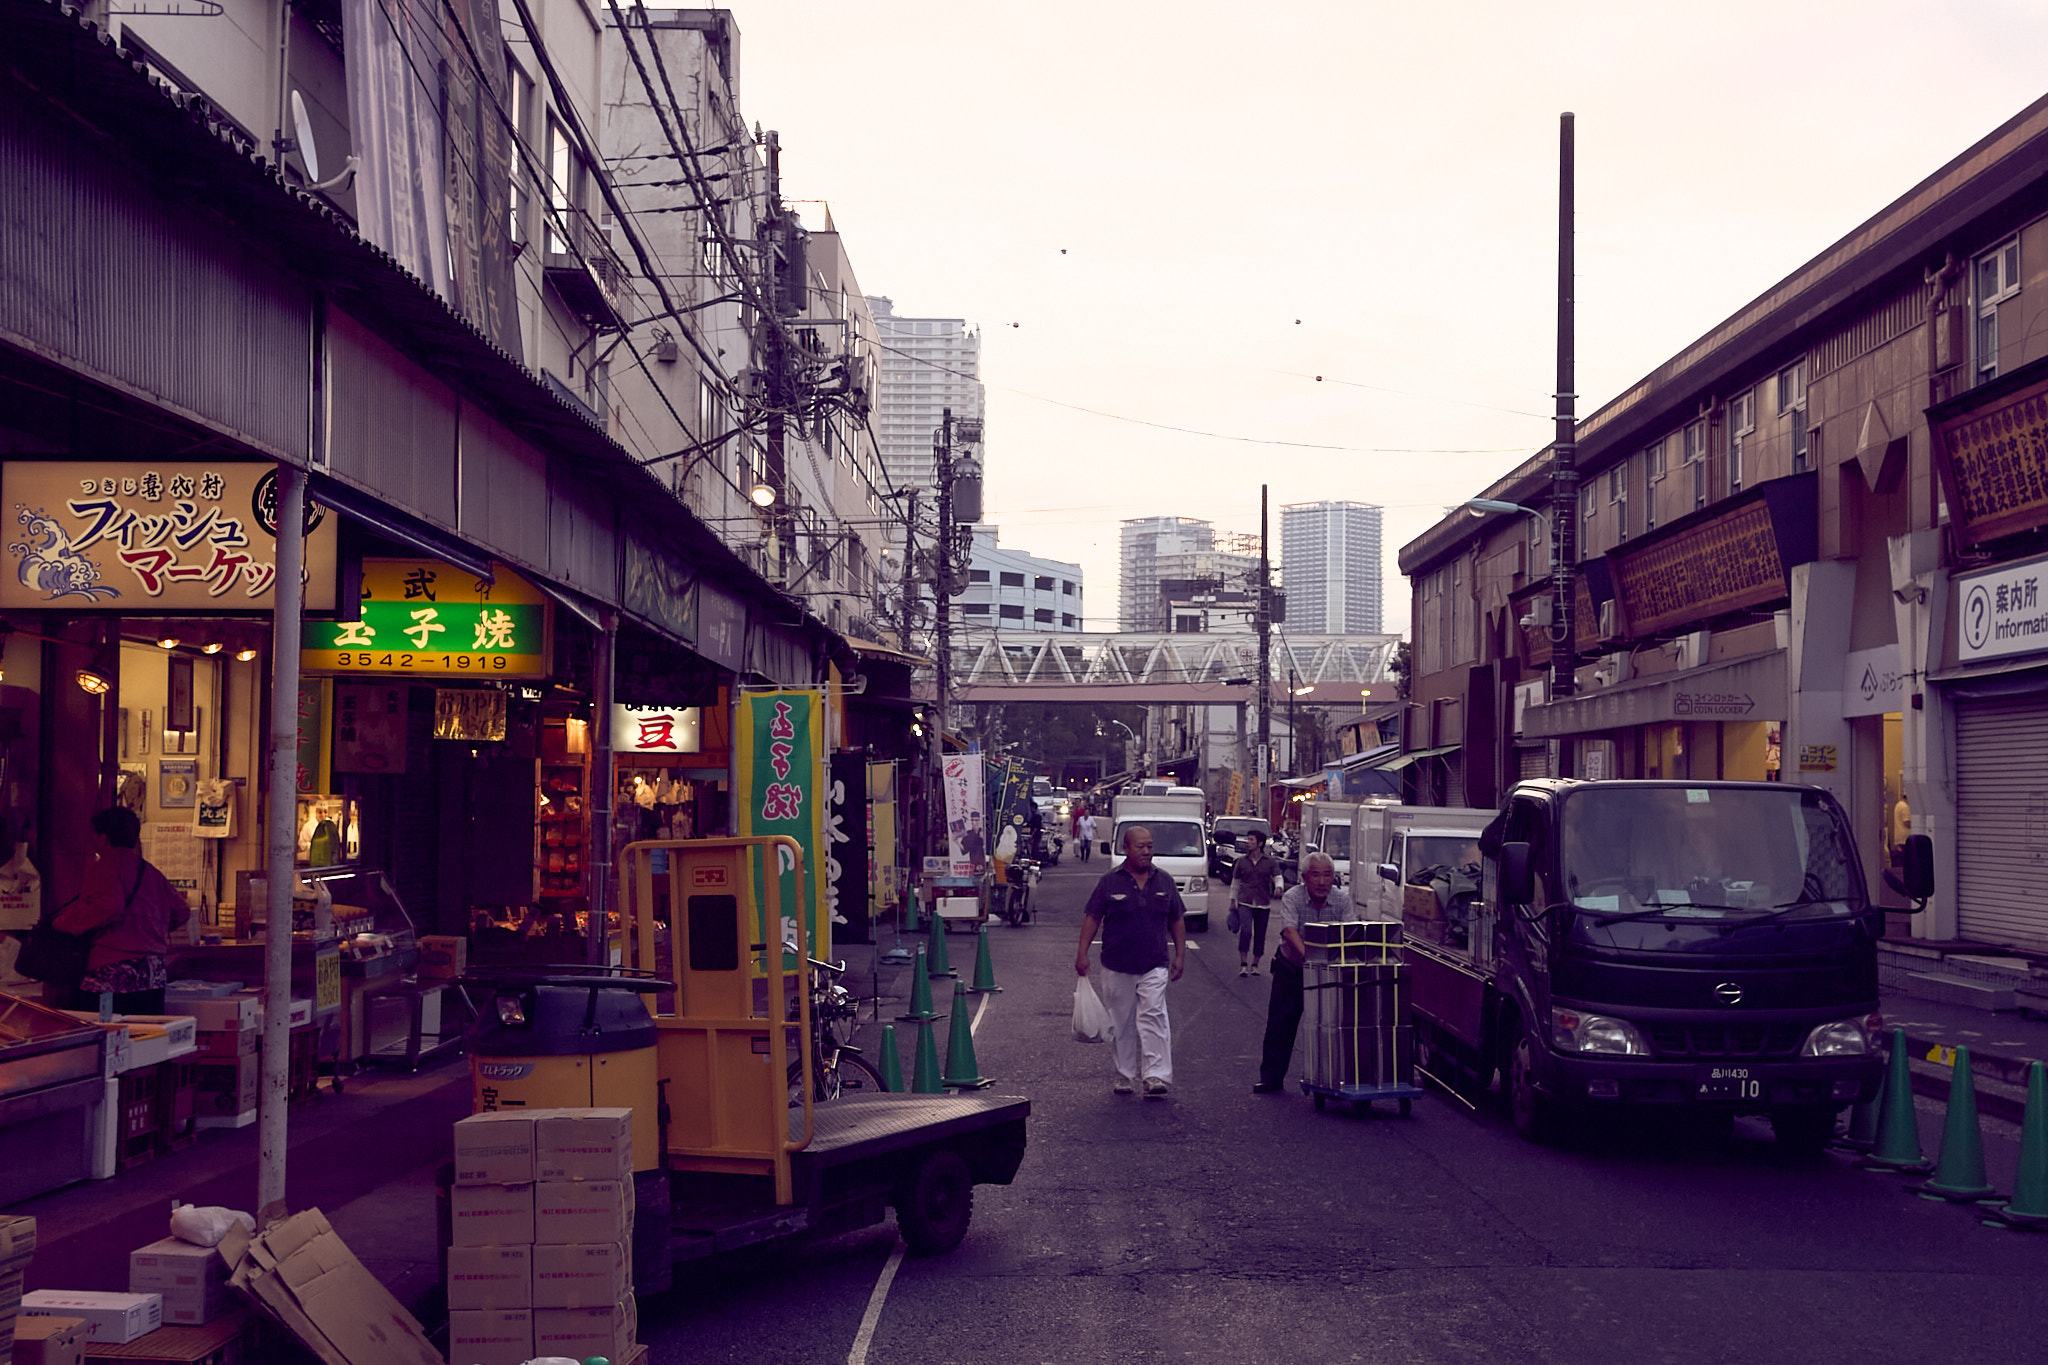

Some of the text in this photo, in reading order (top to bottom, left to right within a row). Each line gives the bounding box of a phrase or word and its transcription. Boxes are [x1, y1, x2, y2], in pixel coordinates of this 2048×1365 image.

[81, 472, 224, 500] つきじ喜代村
[66, 497, 248, 551] フィッシュ
[117, 548, 309, 598] マーケッ
[1995, 577, 2038, 614] 案内所
[333, 605, 516, 651] 玉子焼
[337, 652, 507, 670] 3542-1919
[1694, 694, 1741, 702] コインロッカー
[1694, 706, 1743, 714] COIN LOCKER
[634, 714, 677, 750] 豆
[1800, 754, 1837, 763] ロッカー
[1809, 746, 1836, 755] コイン
[695, 870, 726, 883] ニチユ
